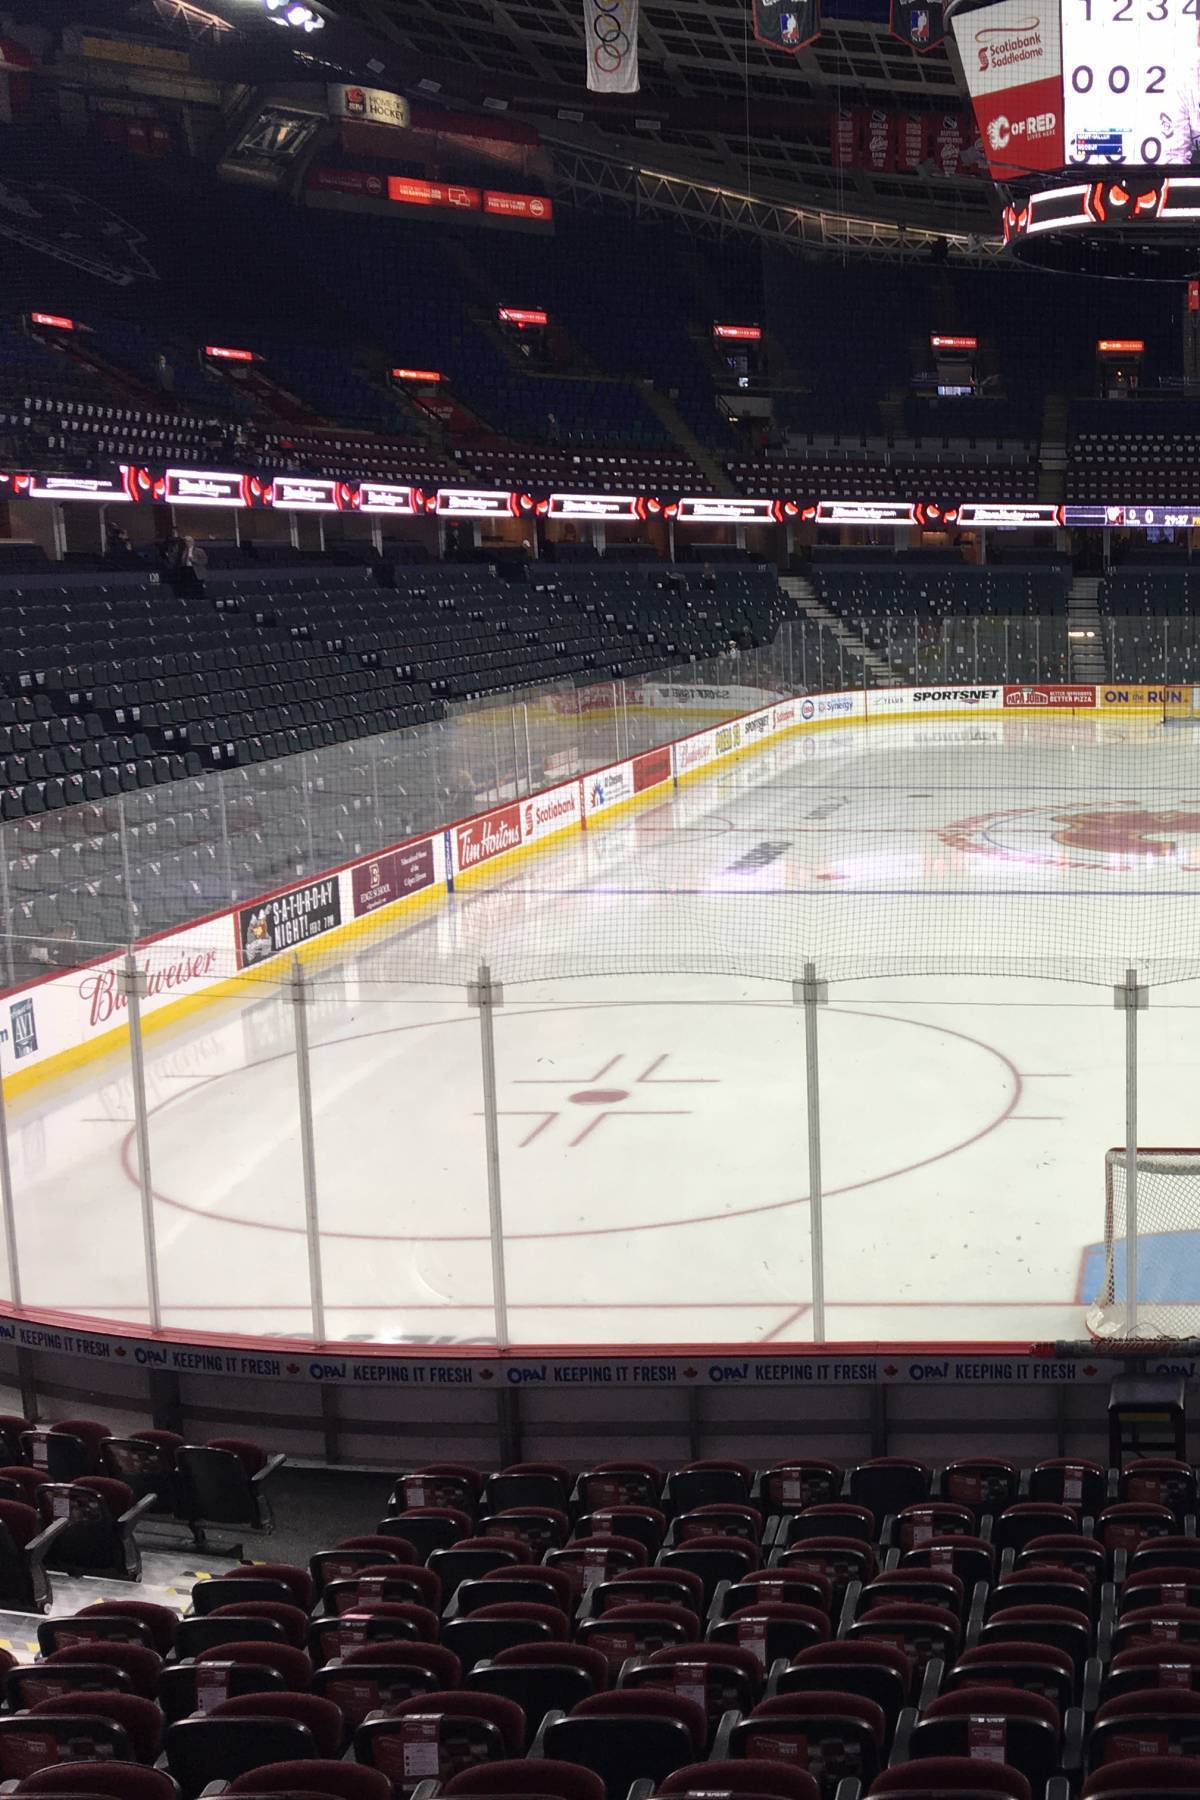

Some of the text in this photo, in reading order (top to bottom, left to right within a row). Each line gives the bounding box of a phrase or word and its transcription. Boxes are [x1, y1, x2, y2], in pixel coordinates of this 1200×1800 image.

[990, 32, 1042, 57] Scotiabank
[991, 46, 1044, 69] Saddledome
[1072, 65, 1093, 93] 0
[1108, 65, 1130, 93] 0
[1145, 65, 1166, 93] 2
[369, 104, 404, 121] HOCKEY
[1011, 123, 1026, 136] OF
[1026, 112, 1056, 133] RED
[826, 700, 854, 712] Synergy
[913, 689, 999, 702] SPORTSNET
[1007, 693, 1025, 704] PAPA
[1105, 691, 1129, 703] ON
[744, 715, 770, 735] SPORTSNET
[535, 793, 576, 825] Scotiabank
[459, 818, 520, 866] Tim Hortons
[274, 914, 310, 951] NIGHT!
[19, 1328, 62, 1352] KEEPING
[64, 1334, 74, 1353] IT
[75, 1336, 111, 1358] FRESH
[134, 1346, 281, 1378] OPA! KEEPING IT FRESH
[309, 1362, 473, 1384] OPA! KEEPING IT FRESH
[708, 1363, 877, 1382] OPA! KEEPING IT FRESH
[909, 1362, 1077, 1382] OPA! KEEPING IT FRESH
[506, 1364, 677, 1384] OPA! KEEPING IT FRESH
